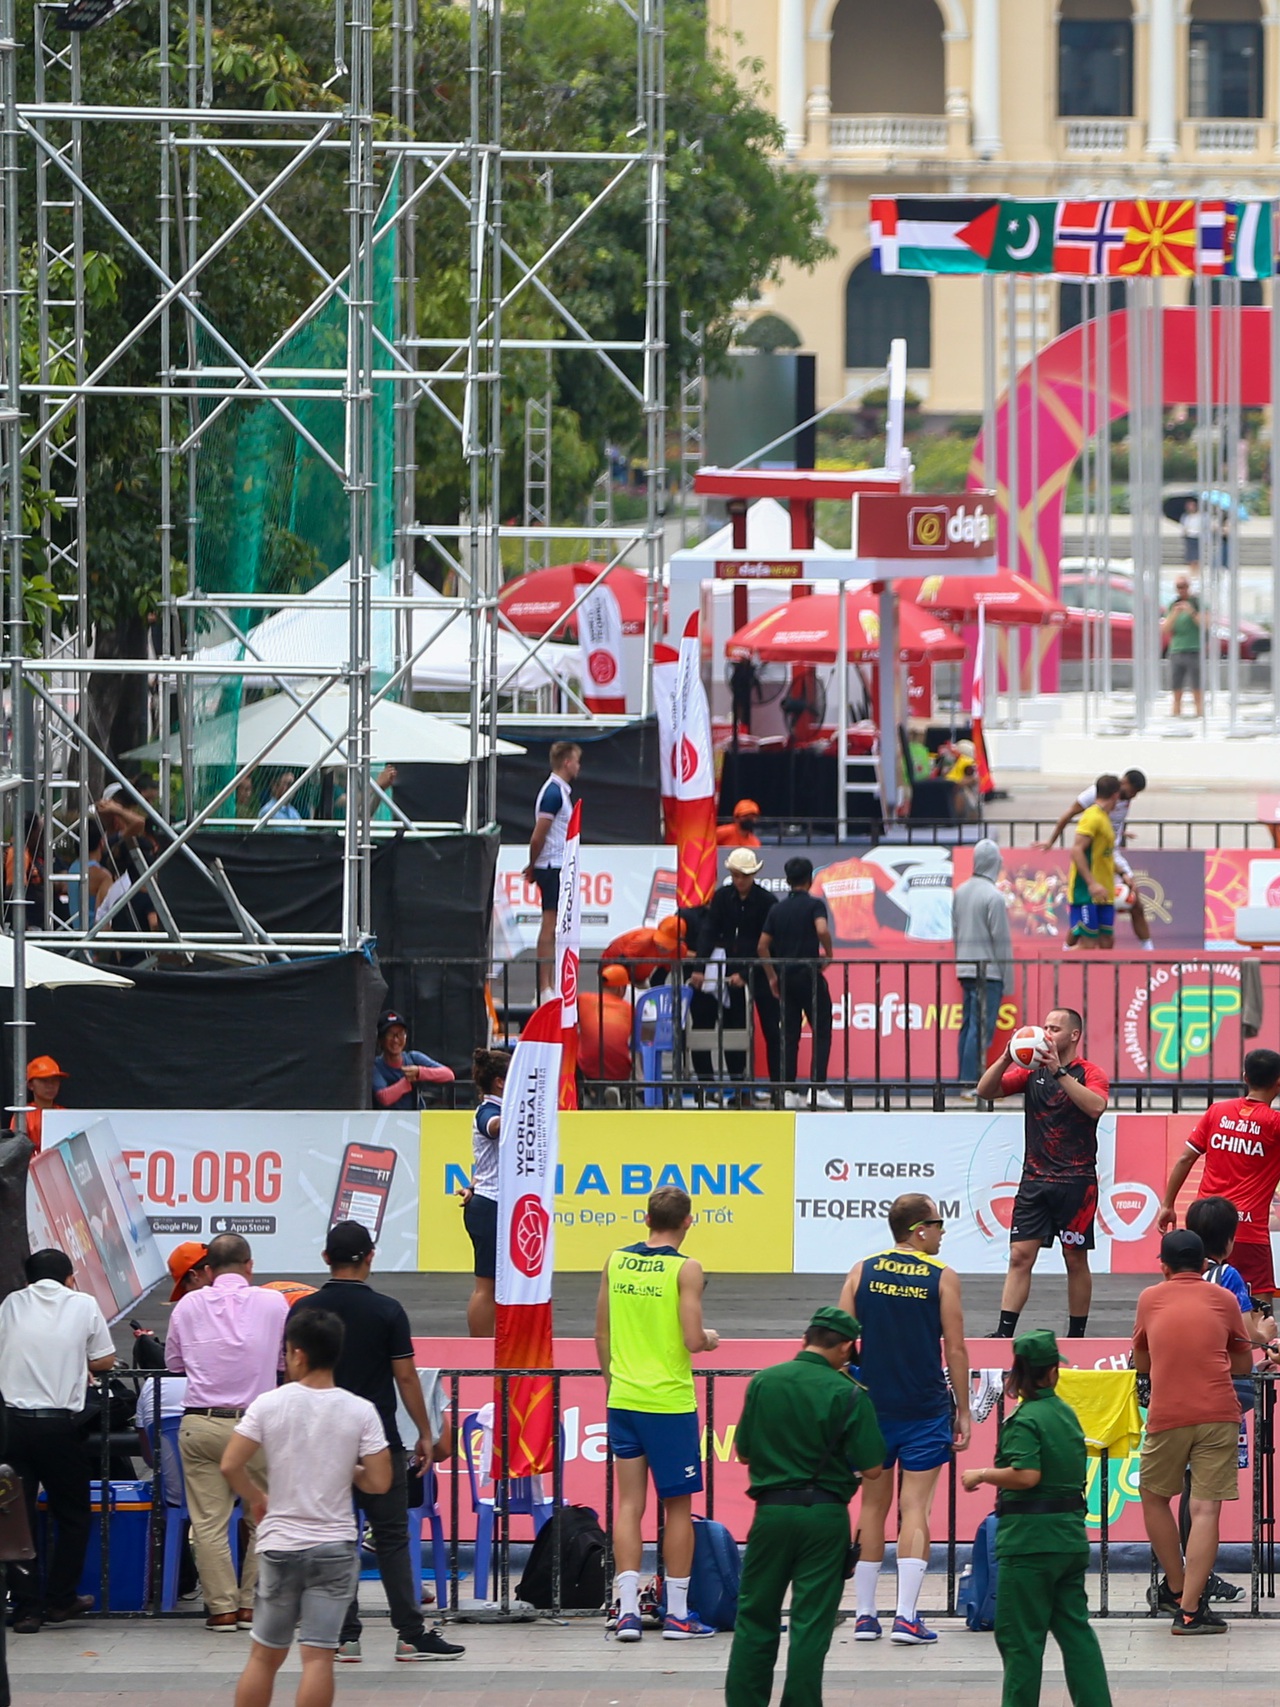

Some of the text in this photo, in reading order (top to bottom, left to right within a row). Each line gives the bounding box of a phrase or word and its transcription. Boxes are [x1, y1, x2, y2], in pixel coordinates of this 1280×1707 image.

[525, 1068, 538, 1178] TEQBALL
[1219, 1116, 1235, 1130] Sun
[1249, 1121, 1261, 1135] Xu
[516, 1100, 526, 1177] WORLD
[1210, 1133, 1265, 1157] CHINA
[121, 1150, 282, 1208] EQ.ORG
[377, 1169, 391, 1182] FIT
[574, 1164, 611, 1195] A
[621, 1164, 764, 1195] BANK
[854, 1162, 935, 1179] TEQERS
[796, 1199, 961, 1222] TEQERSM
[1115, 1200, 1142, 1210] TEQBALL
[153, 1221, 199, 1233] Google Play
[579, 1209, 617, 1228] Đẹp
[704, 1206, 734, 1224] Tốt
[230, 1223, 271, 1233] App Store
[613, 1282, 663, 1298] UKRAINE
[869, 1280, 929, 1300] UKRAINE
